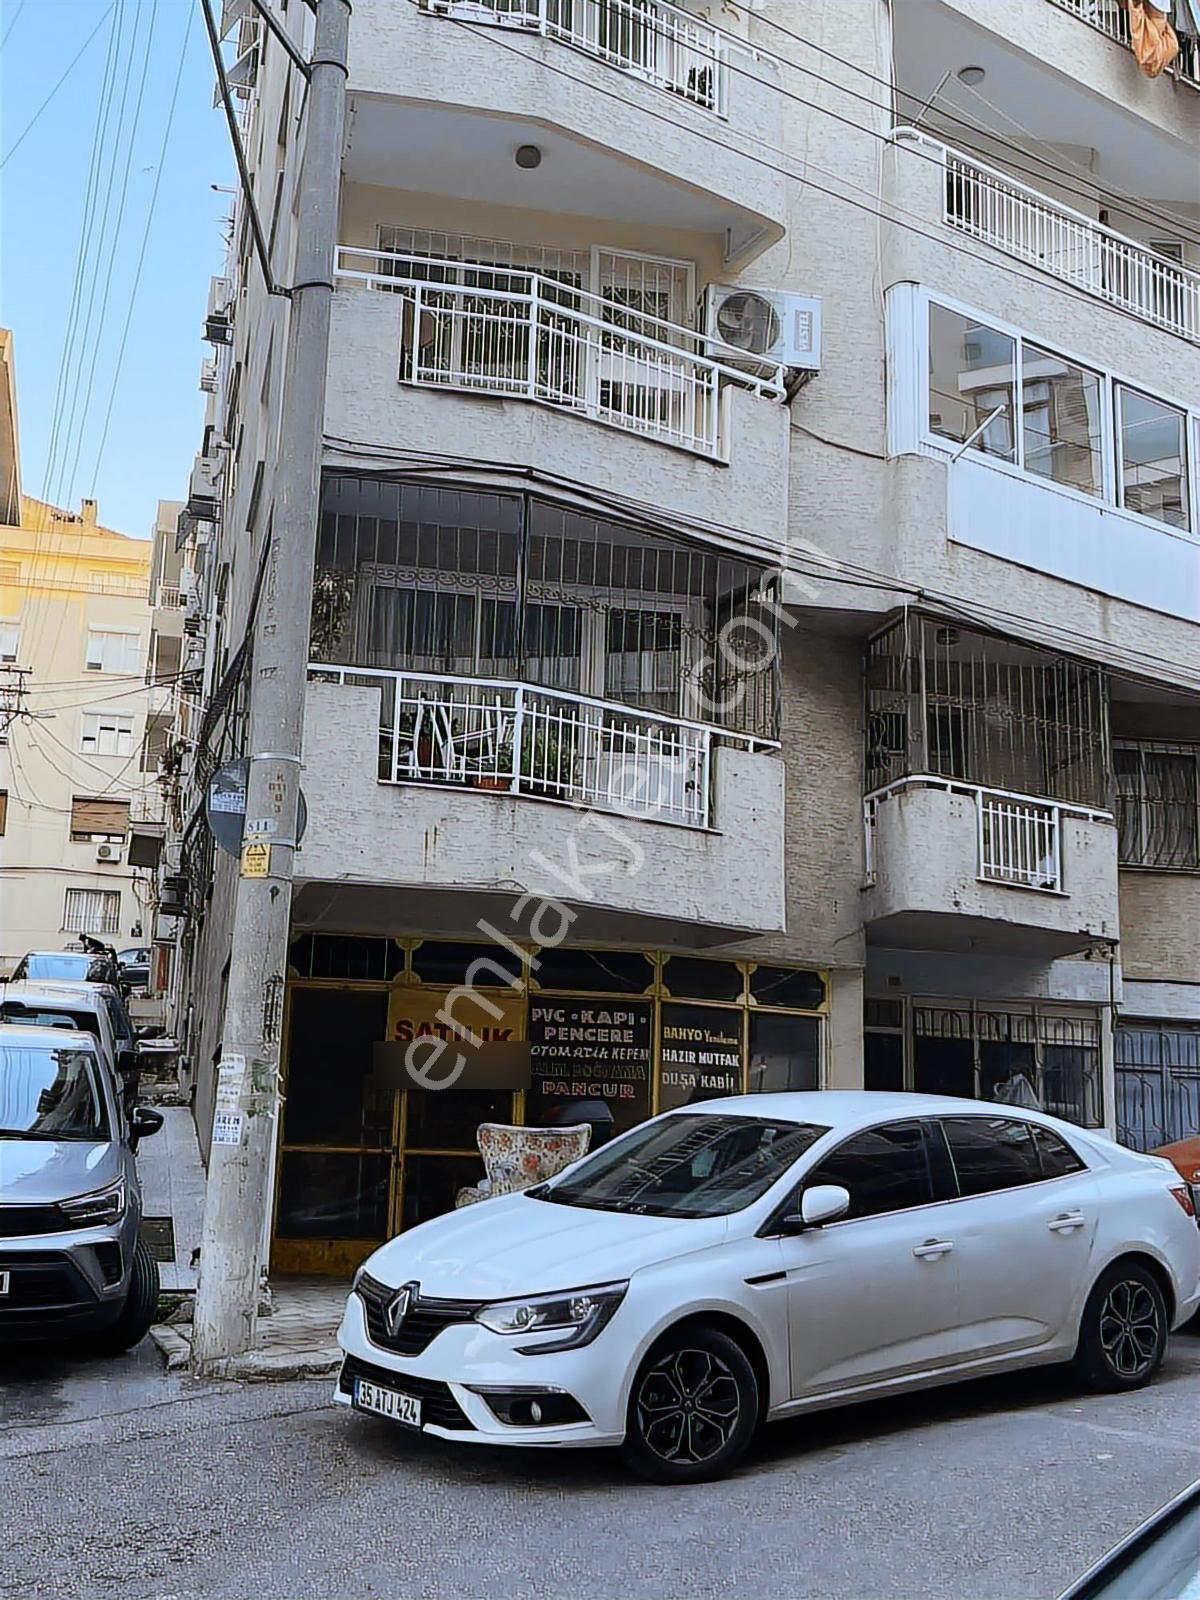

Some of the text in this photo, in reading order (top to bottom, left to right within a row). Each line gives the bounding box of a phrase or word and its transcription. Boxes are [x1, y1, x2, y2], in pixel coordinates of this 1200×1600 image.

[531, 1007, 635, 1026] PVC KAPI
[544, 1026, 634, 1043] PENCERE
[663, 1026, 703, 1041] BANYO
[662, 1048, 740, 1067] HAZIR MUTFAK
[542, 1080, 636, 1098] PANCUR
[360, 1382, 373, 1407] 35
[396, 1395, 417, 1423] 424
